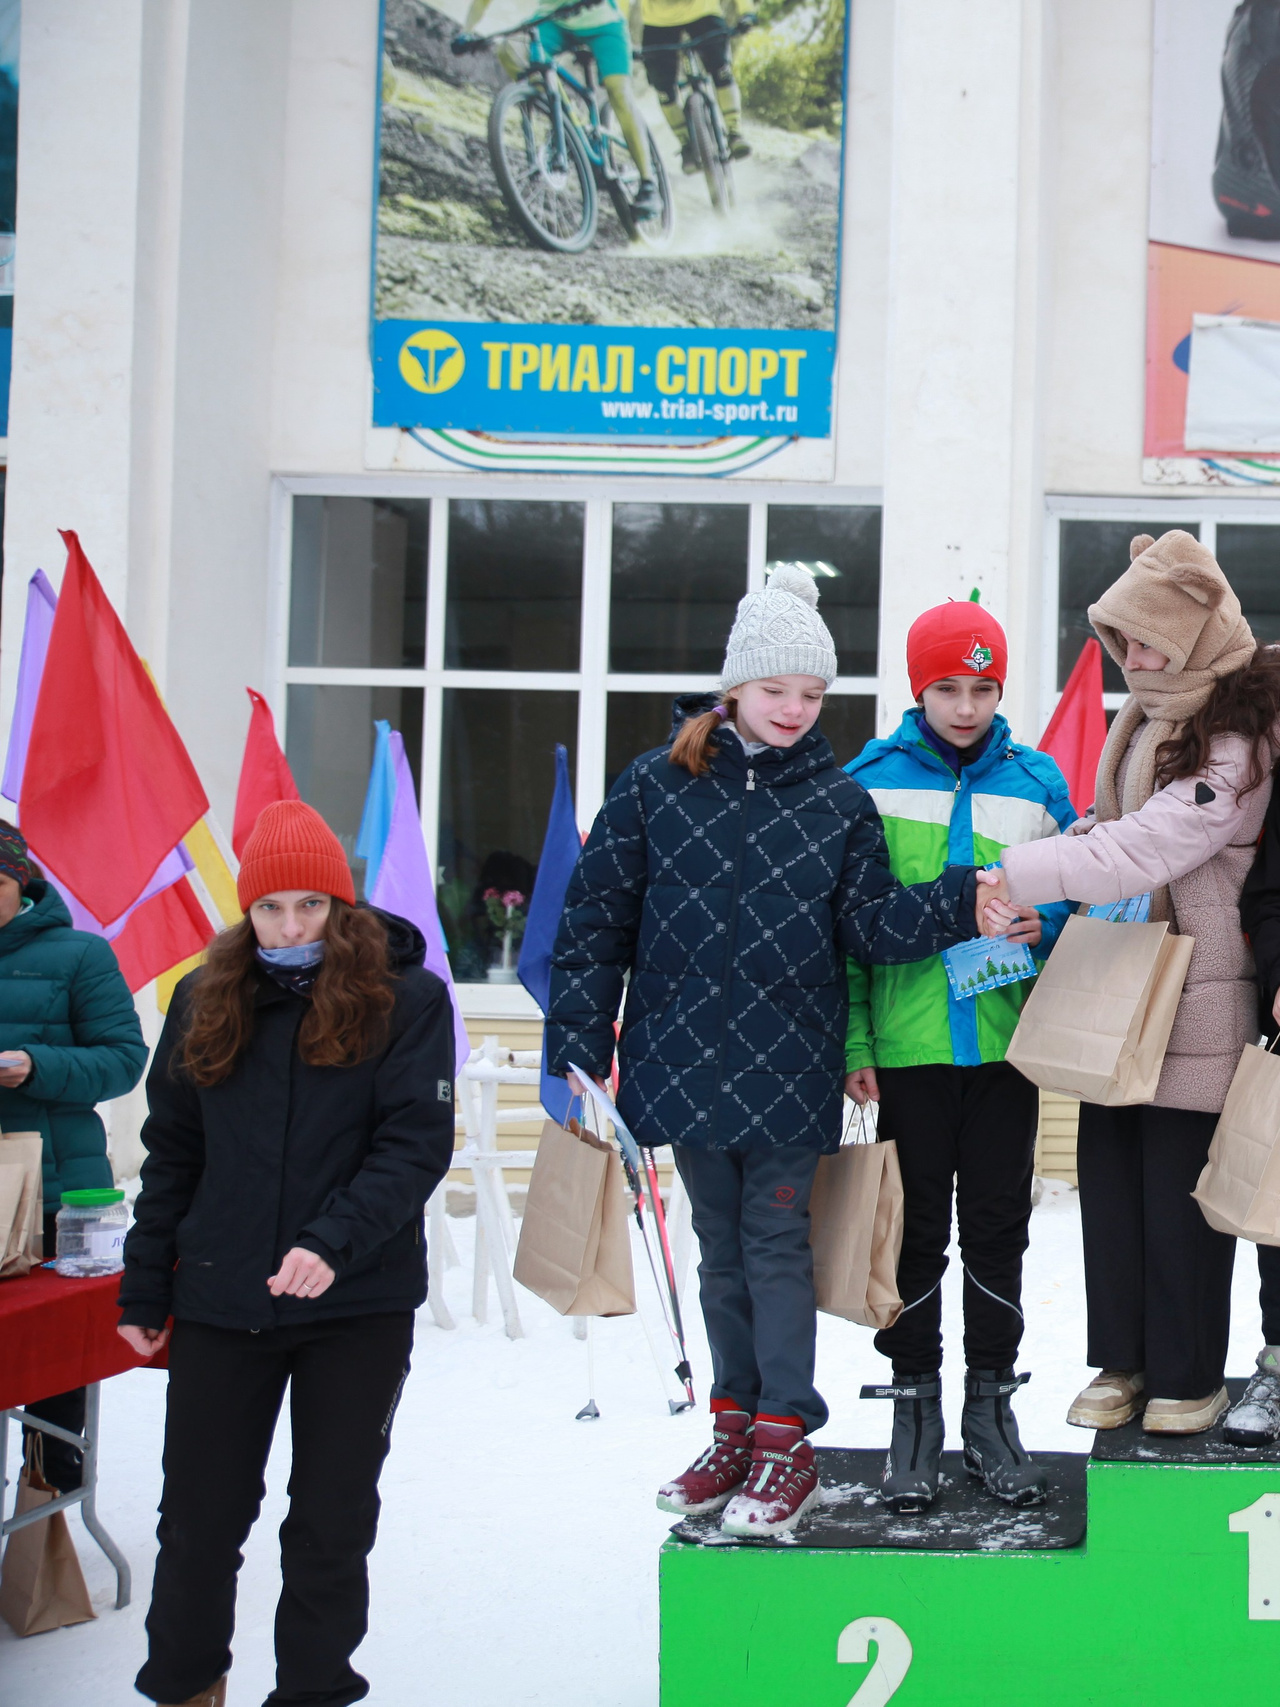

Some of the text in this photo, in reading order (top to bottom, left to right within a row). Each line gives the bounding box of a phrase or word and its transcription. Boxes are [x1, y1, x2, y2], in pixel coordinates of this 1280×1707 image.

[602, 400, 798, 424] www.trial-sport.ru
[762, 1451, 793, 1463] TOREAD
[837, 1616, 912, 1707] 2
